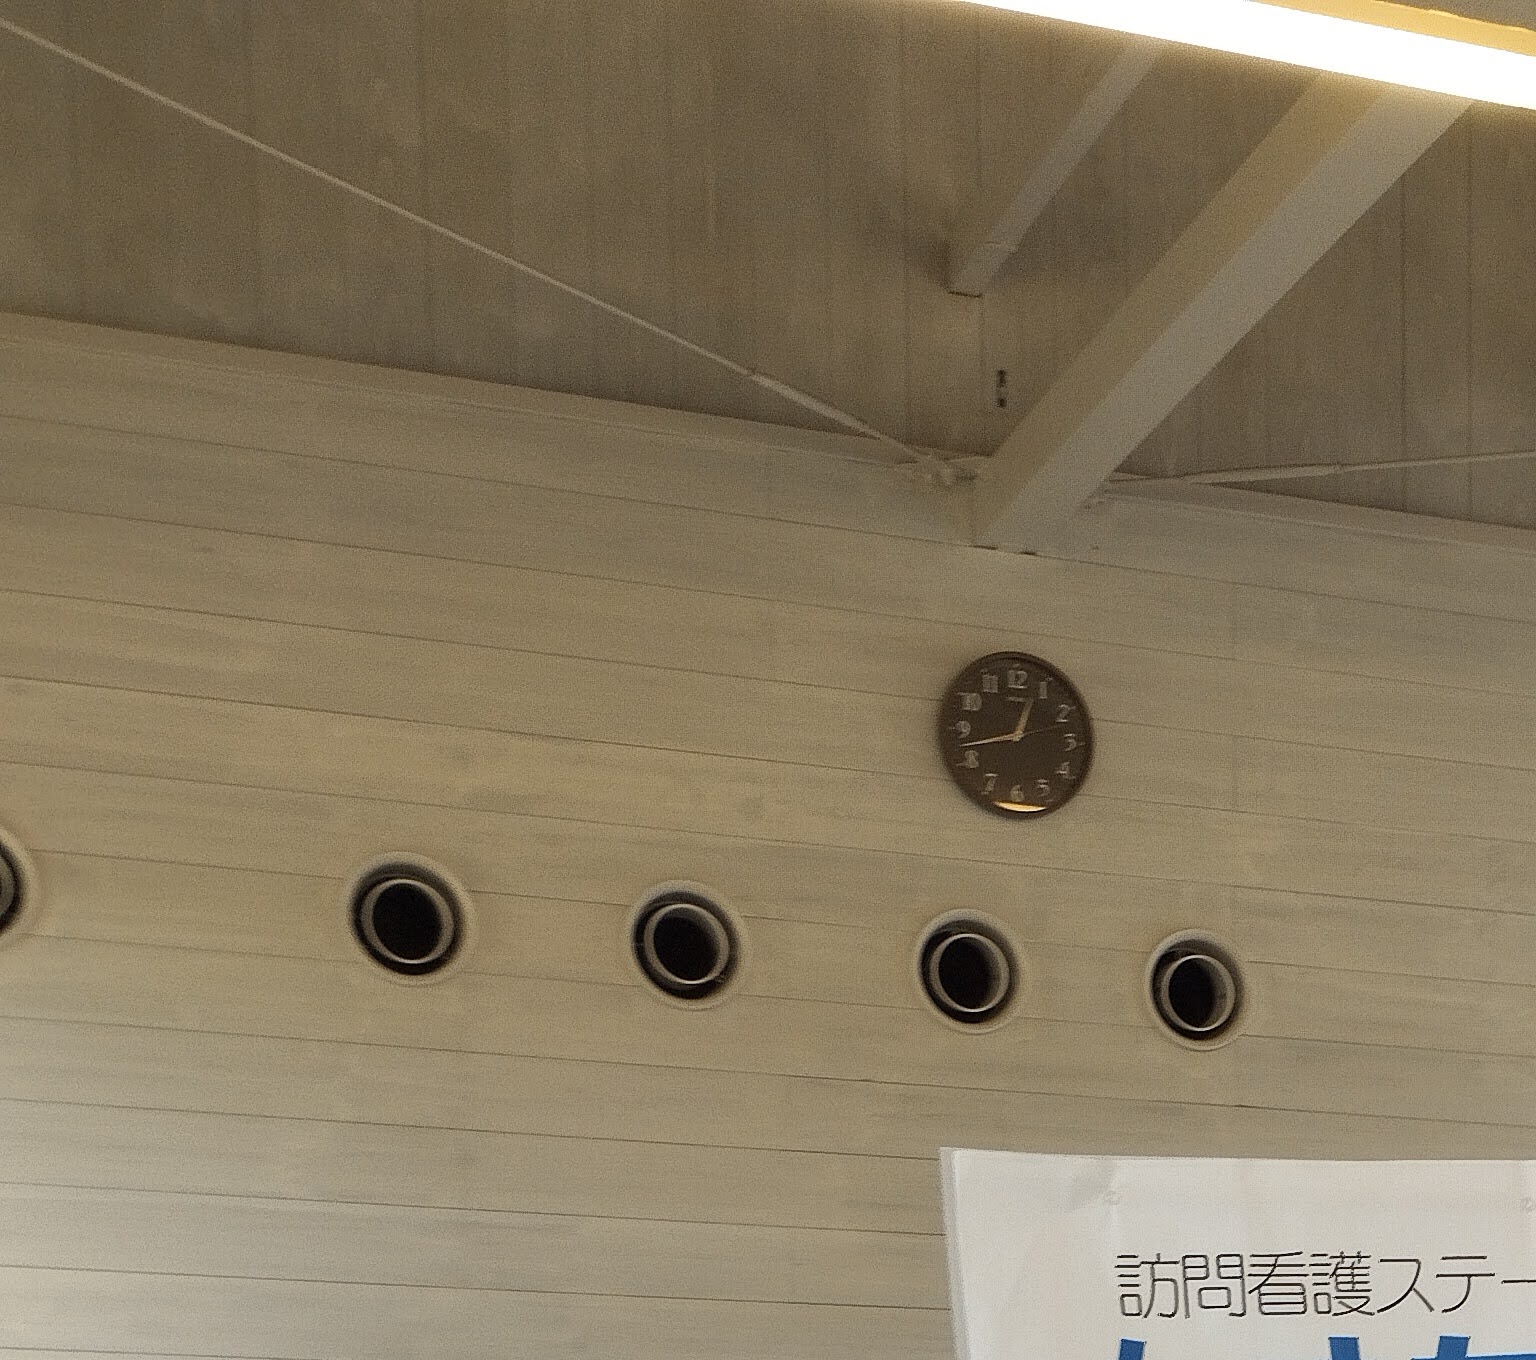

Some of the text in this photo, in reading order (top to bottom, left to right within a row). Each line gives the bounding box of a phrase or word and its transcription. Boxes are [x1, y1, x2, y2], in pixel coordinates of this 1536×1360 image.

[1007, 669, 1028, 689] 12
[1056, 704, 1070, 722] 2
[955, 720, 971, 739] 9
[1064, 733, 1077, 752] 3
[983, 773, 998, 795] 7
[1010, 784, 1025, 802] 6
